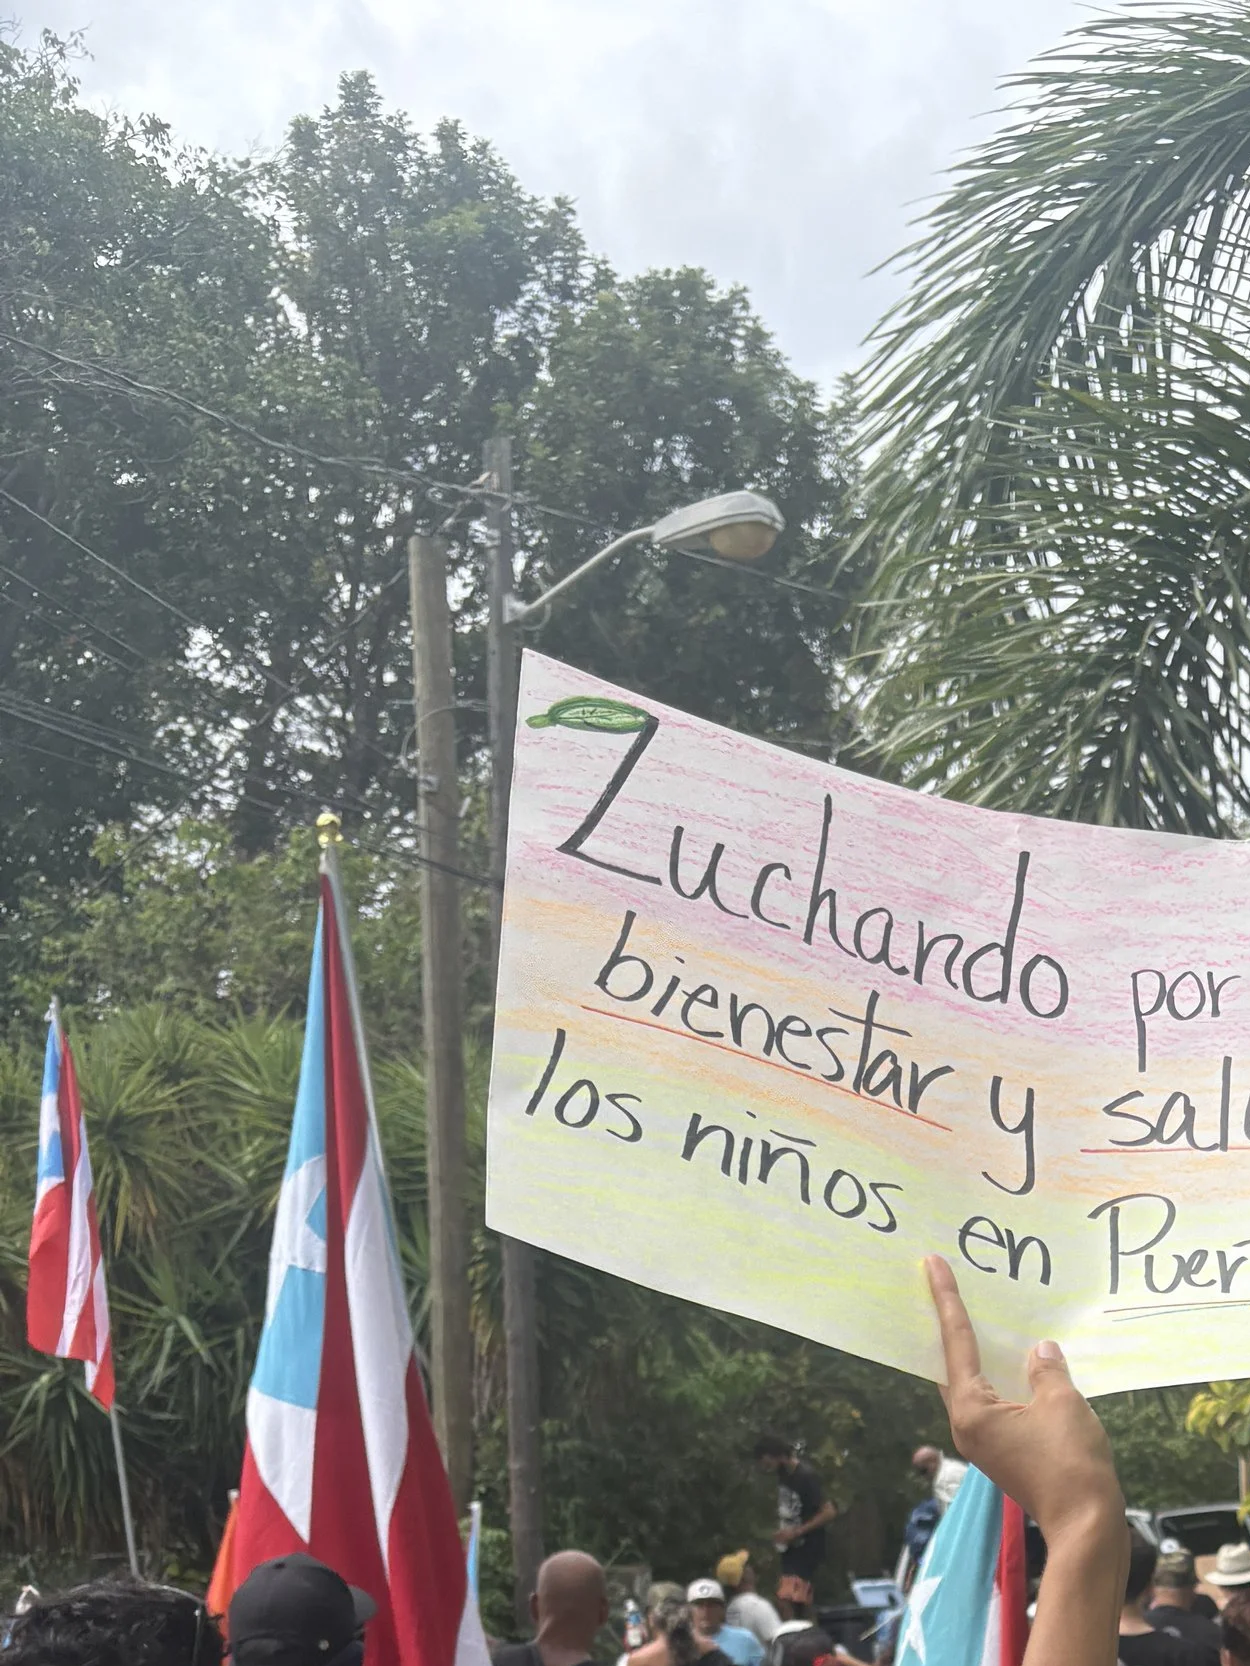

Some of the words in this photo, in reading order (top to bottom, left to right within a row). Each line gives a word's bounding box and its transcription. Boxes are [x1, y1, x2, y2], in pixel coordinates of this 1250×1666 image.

[530, 697, 1070, 1019] Zuchando
[1131, 970, 1242, 1071] por
[525, 1028, 645, 1143] los
[681, 1112, 902, 1234] niños
[958, 1214, 1052, 1287] en
[595, 909, 955, 1115] bienestar
[982, 1075, 1036, 1195] y
